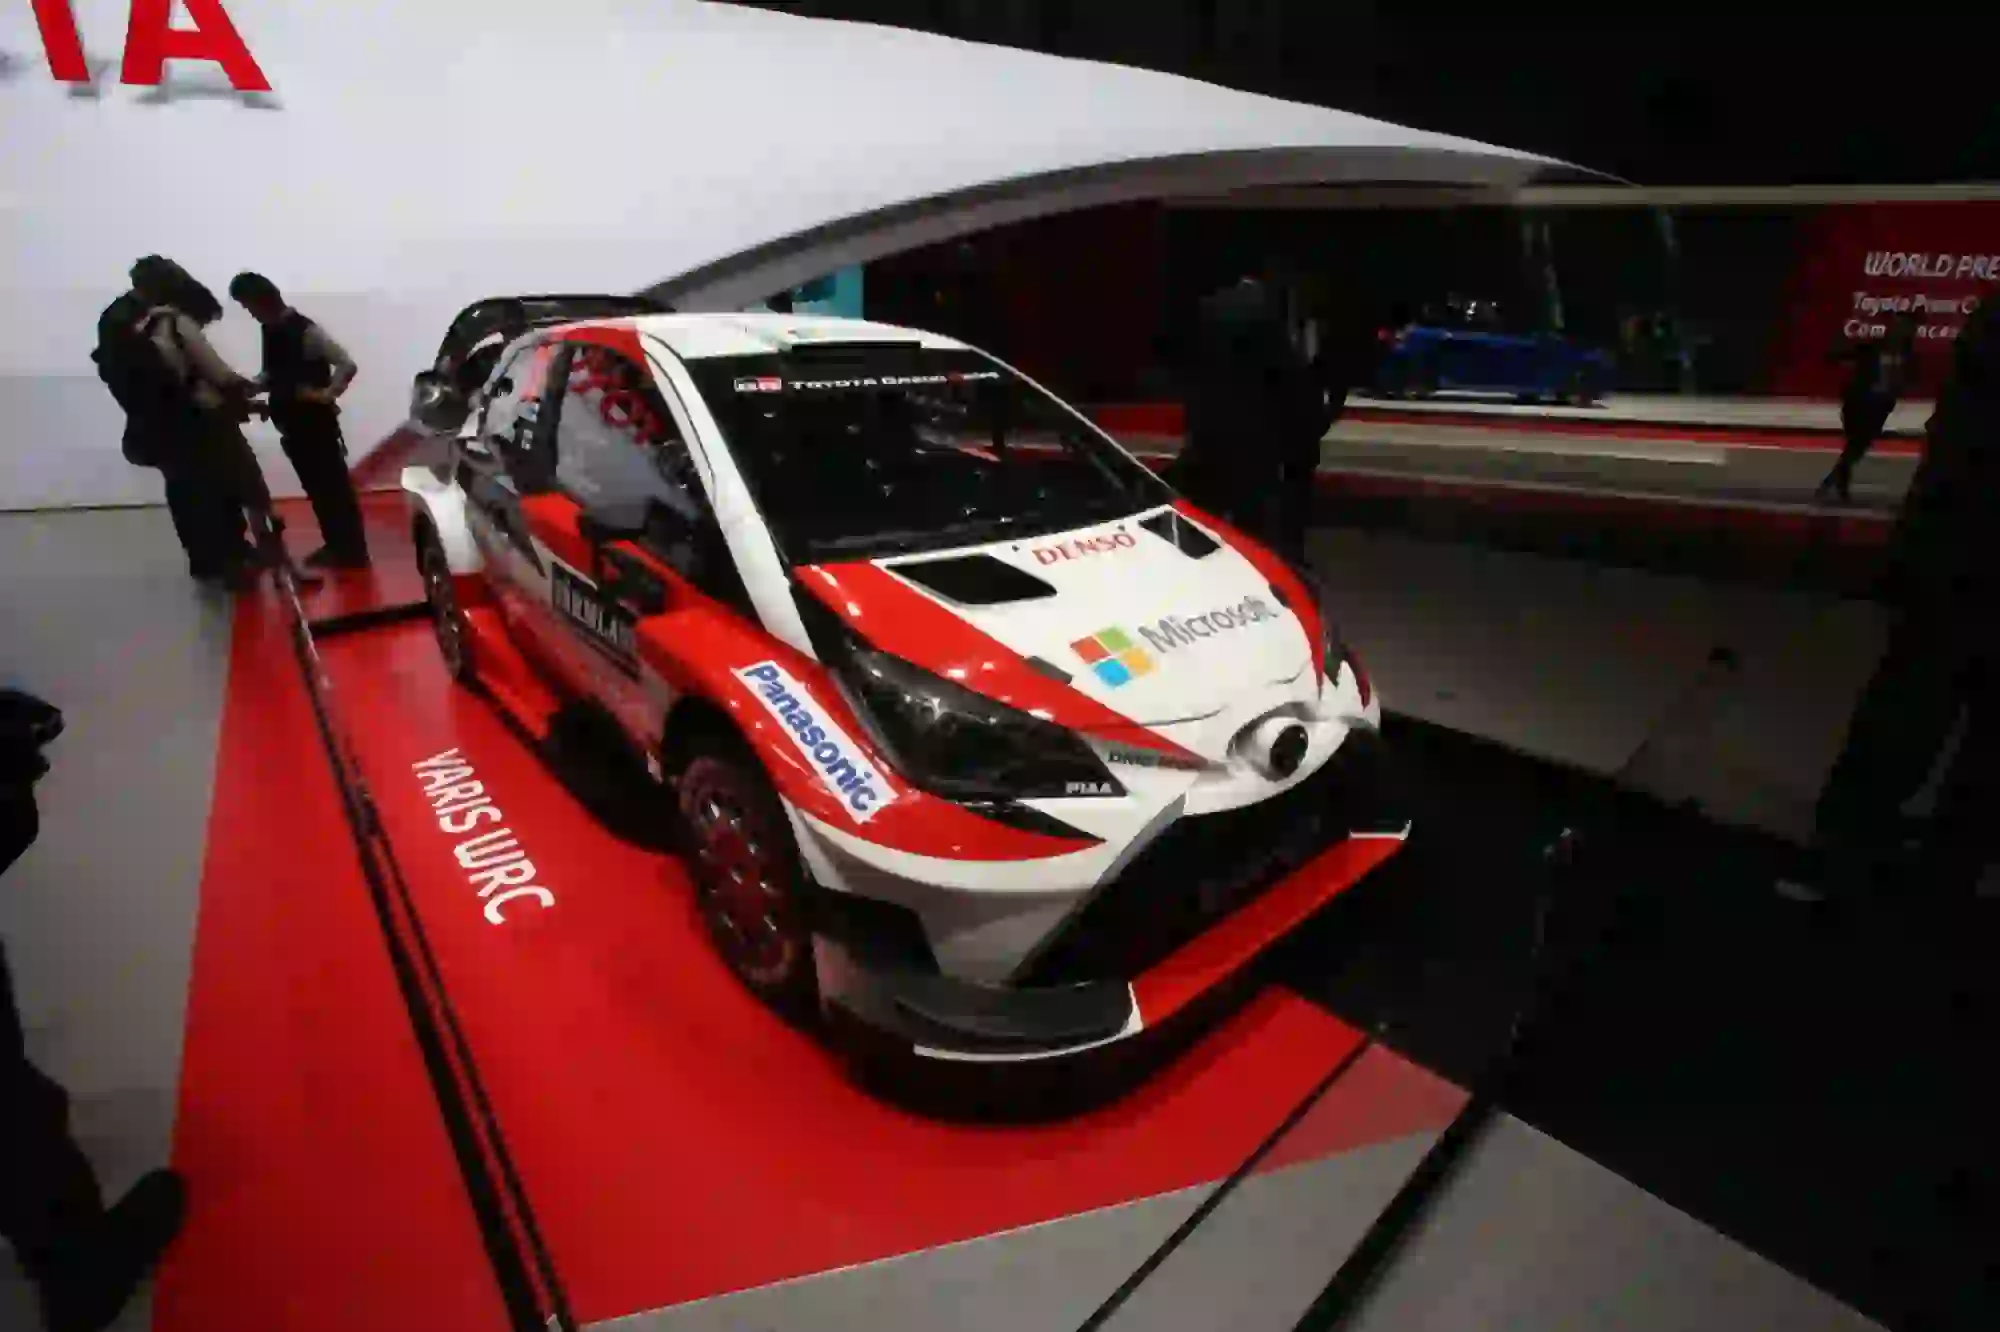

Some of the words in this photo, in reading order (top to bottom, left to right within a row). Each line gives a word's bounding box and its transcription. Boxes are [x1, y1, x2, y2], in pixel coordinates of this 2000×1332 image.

[1864, 252, 1953, 277] WORLD
[1032, 533, 1136, 566] DENSO
[1138, 595, 1280, 653] Microsoft
[744, 665, 877, 811] Panasonic
[412, 748, 503, 834] YARIS
[454, 828, 556, 925] WRC
